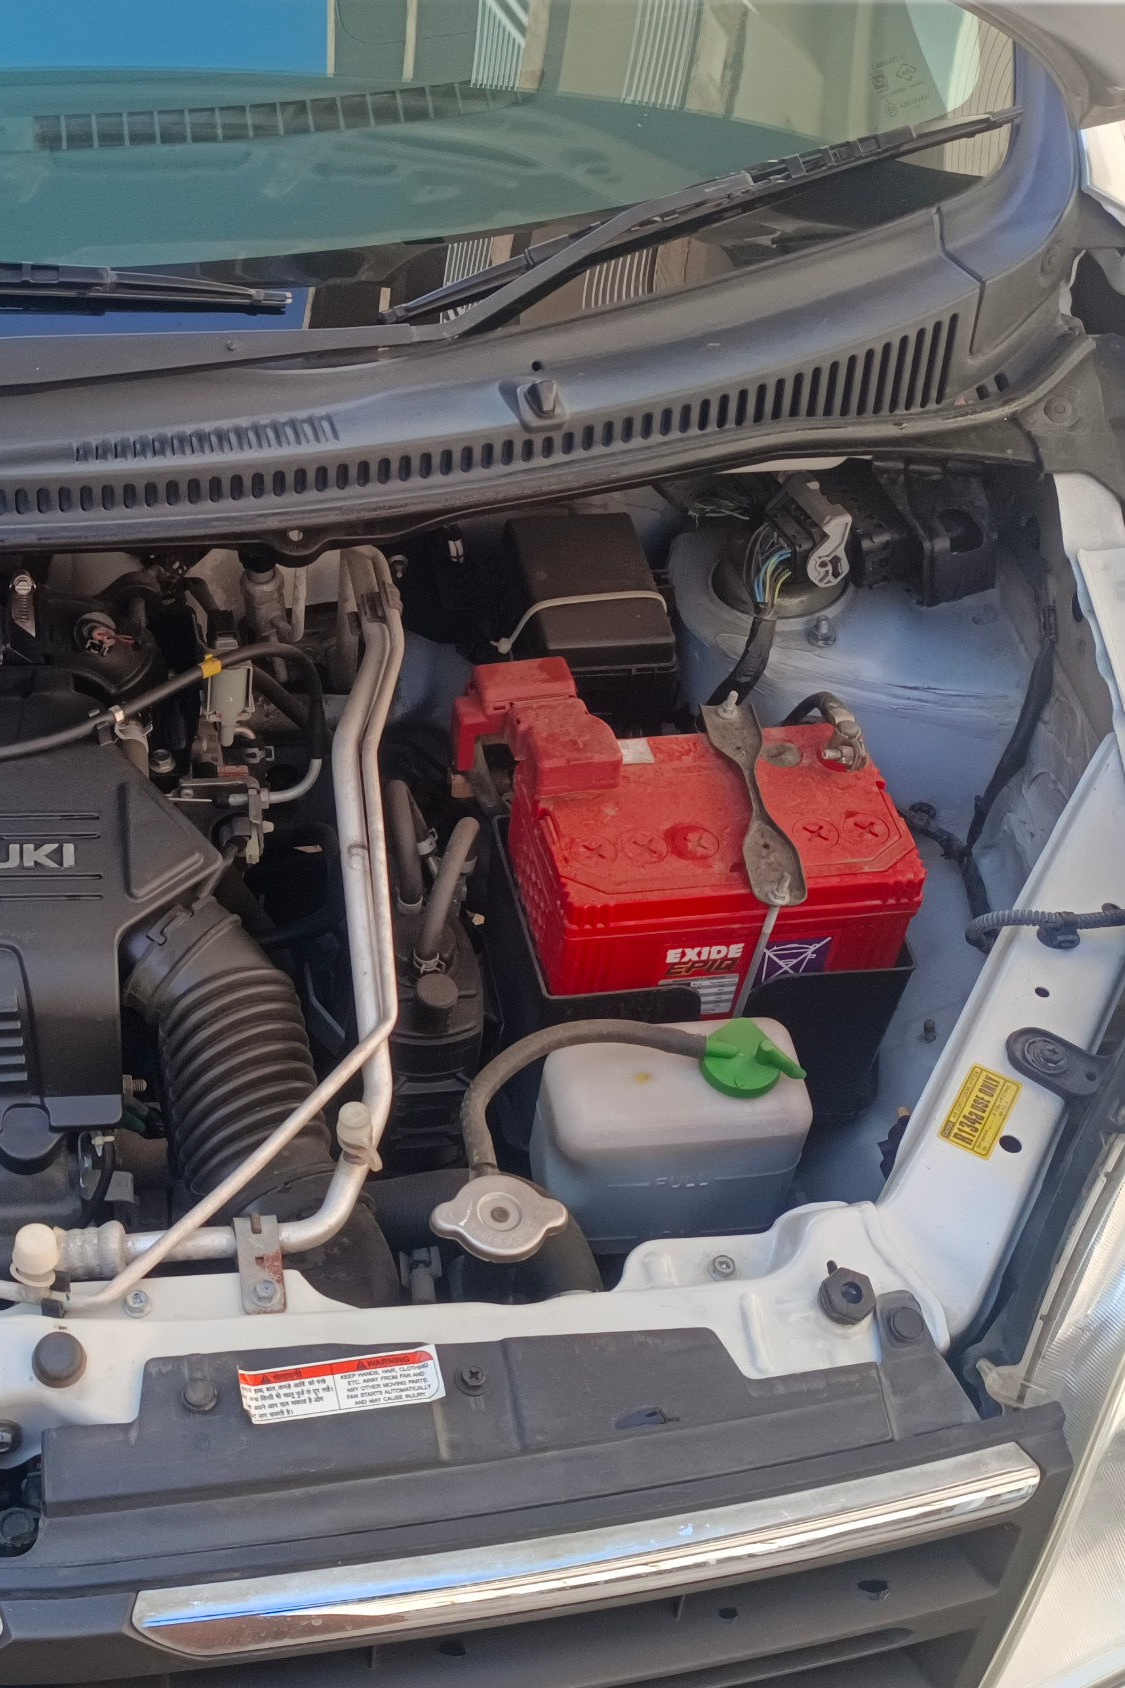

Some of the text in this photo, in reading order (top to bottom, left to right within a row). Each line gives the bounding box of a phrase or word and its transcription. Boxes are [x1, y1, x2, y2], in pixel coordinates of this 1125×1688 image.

[665, 943, 745, 964] EXIDE
[664, 959, 738, 977] EPIQ
[979, 1075, 1000, 1097] ONLY
[971, 1095, 990, 1113] USE
[953, 1111, 985, 1145] R134a
[656, 1173, 708, 1188] FULL
[367, 1356, 409, 1367] WARNING
[399, 1363, 428, 1371] CLOTHING
[385, 1384, 431, 1394] AUTOMATICALLY
